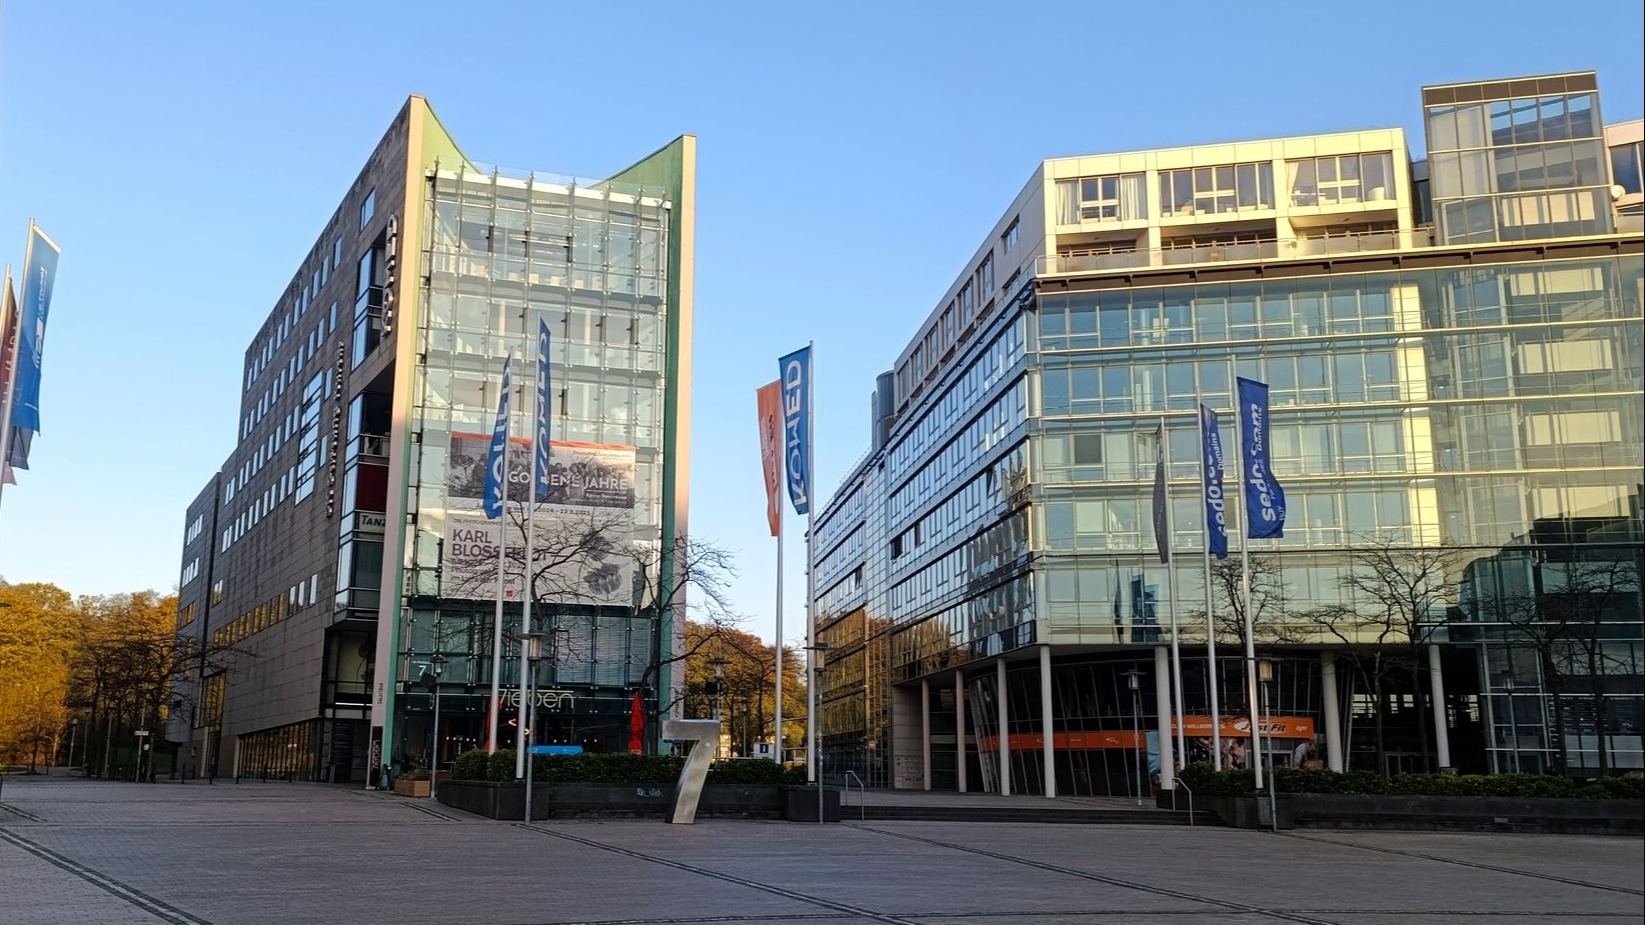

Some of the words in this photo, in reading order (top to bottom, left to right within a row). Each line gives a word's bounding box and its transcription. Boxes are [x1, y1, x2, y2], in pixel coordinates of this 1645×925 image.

[786, 360, 806, 506] KOMED
[1211, 432, 1224, 471] Domains
[508, 470, 580, 487] GOENE
[584, 475, 629, 490] JAHRE
[452, 529, 493, 544] KARL
[452, 543, 547, 561] BLOSSFELT
[418, 665, 427, 676] 7
[1241, 721, 1267, 732] Jst
[1271, 723, 1286, 732] Fit
